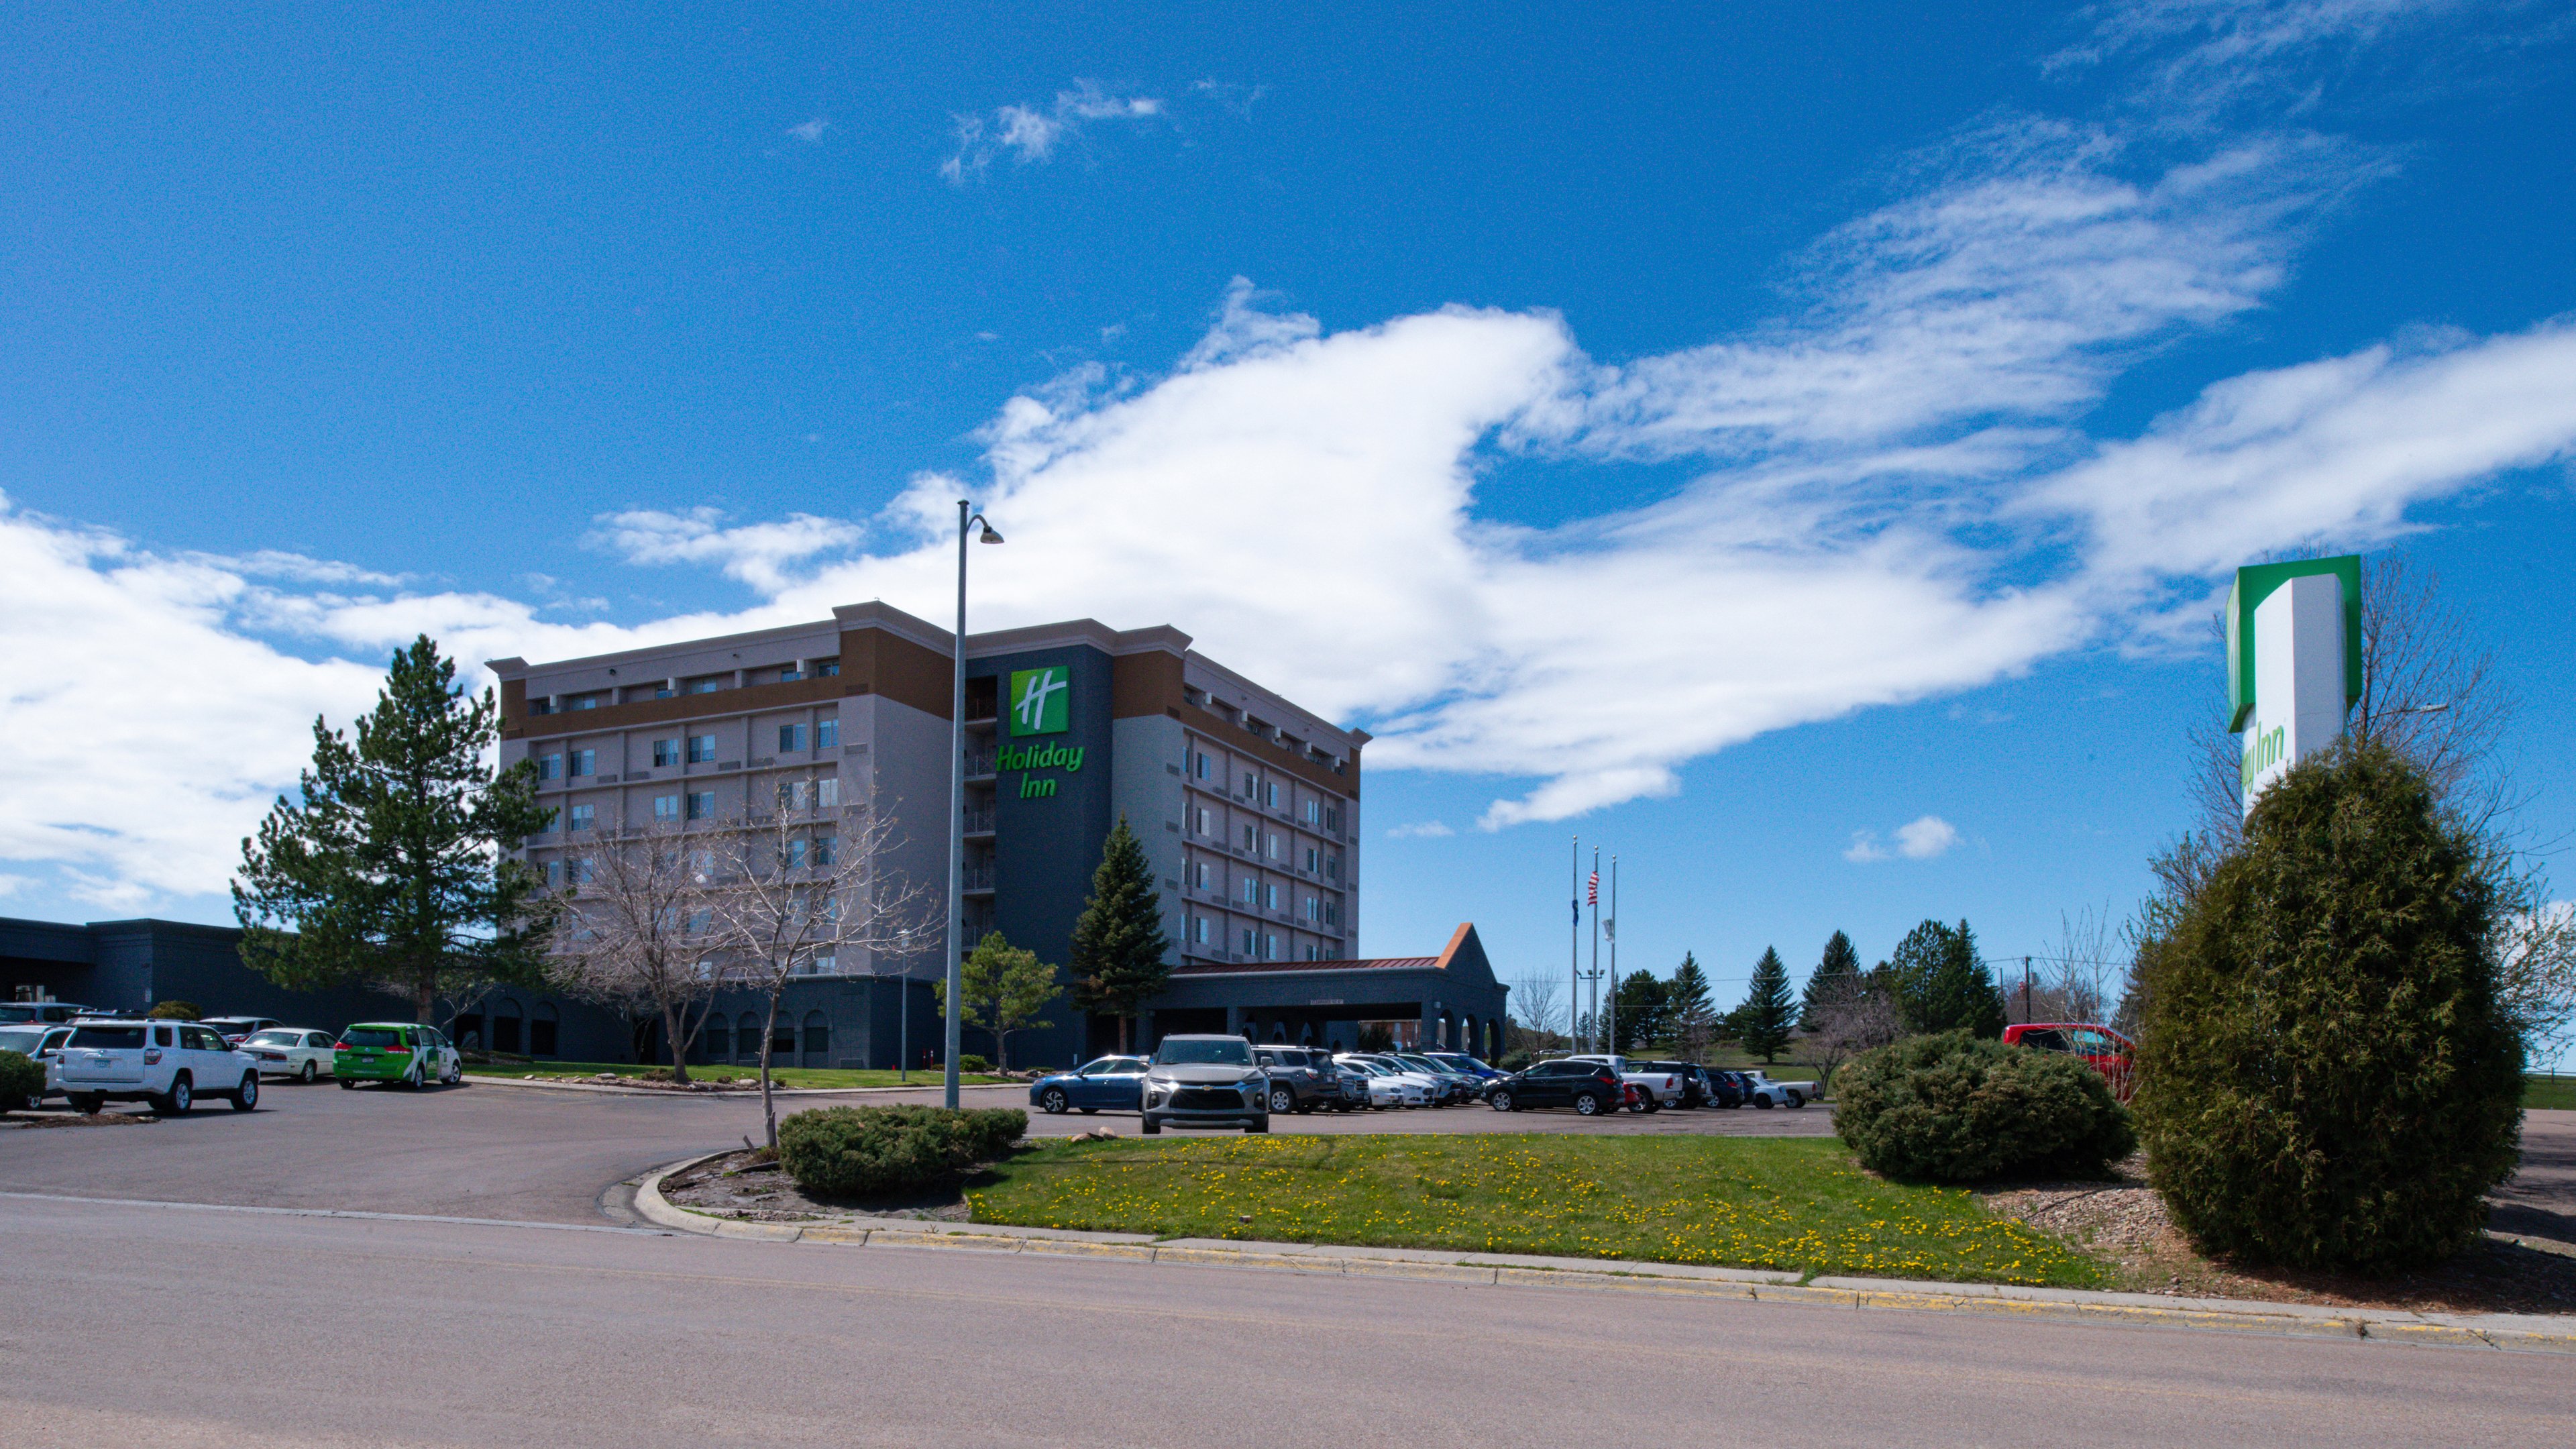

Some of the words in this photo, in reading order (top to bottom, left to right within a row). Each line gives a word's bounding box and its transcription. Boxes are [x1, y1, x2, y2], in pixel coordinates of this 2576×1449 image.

[1016, 671, 1067, 730] H
[995, 741, 1085, 771] Holiday
[2256, 720, 2284, 774] Inn
[1020, 772, 1057, 799] Inn
